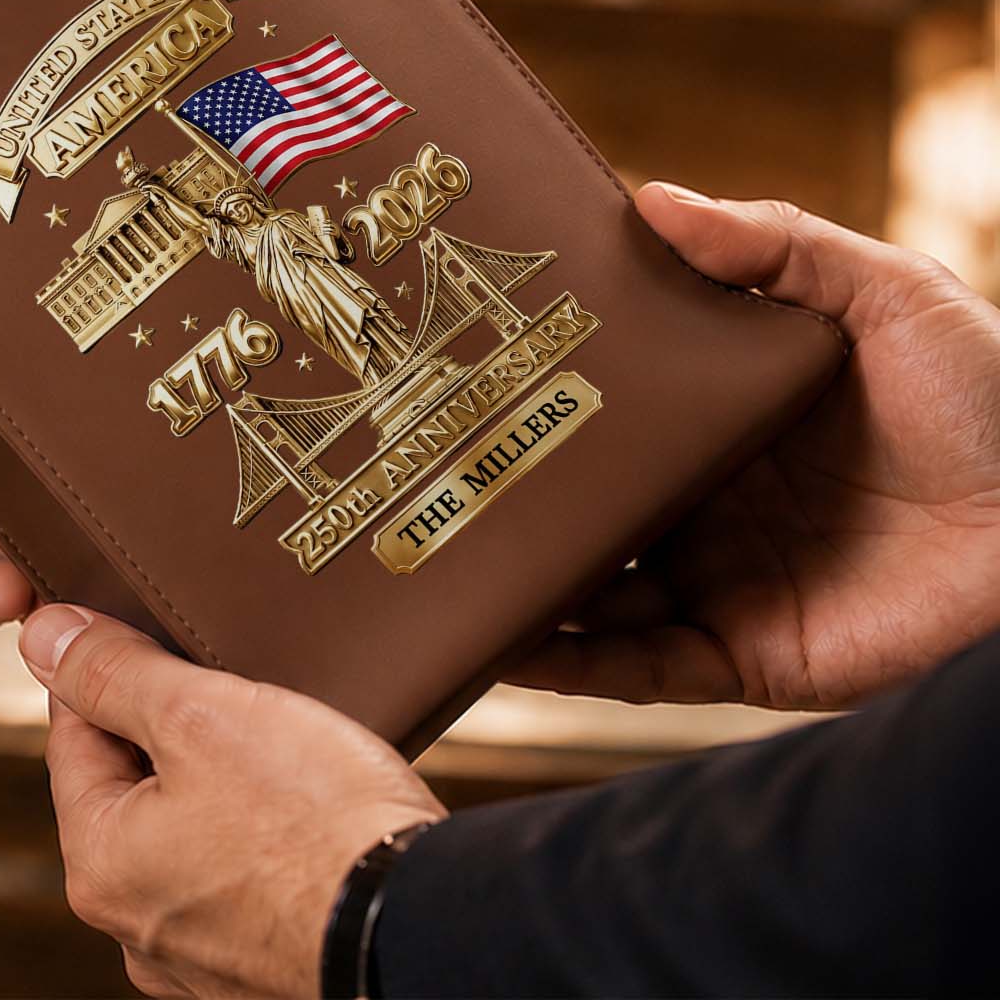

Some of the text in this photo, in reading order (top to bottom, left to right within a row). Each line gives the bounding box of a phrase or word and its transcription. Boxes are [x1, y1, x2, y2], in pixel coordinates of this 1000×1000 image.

[46, 7, 227, 170] AMERICA
[344, 143, 472, 267] 2026
[148, 308, 281, 437] 1776
[297, 308, 591, 562] 250th ANNIVERSARY
[397, 390, 579, 551] THE MILLERS
